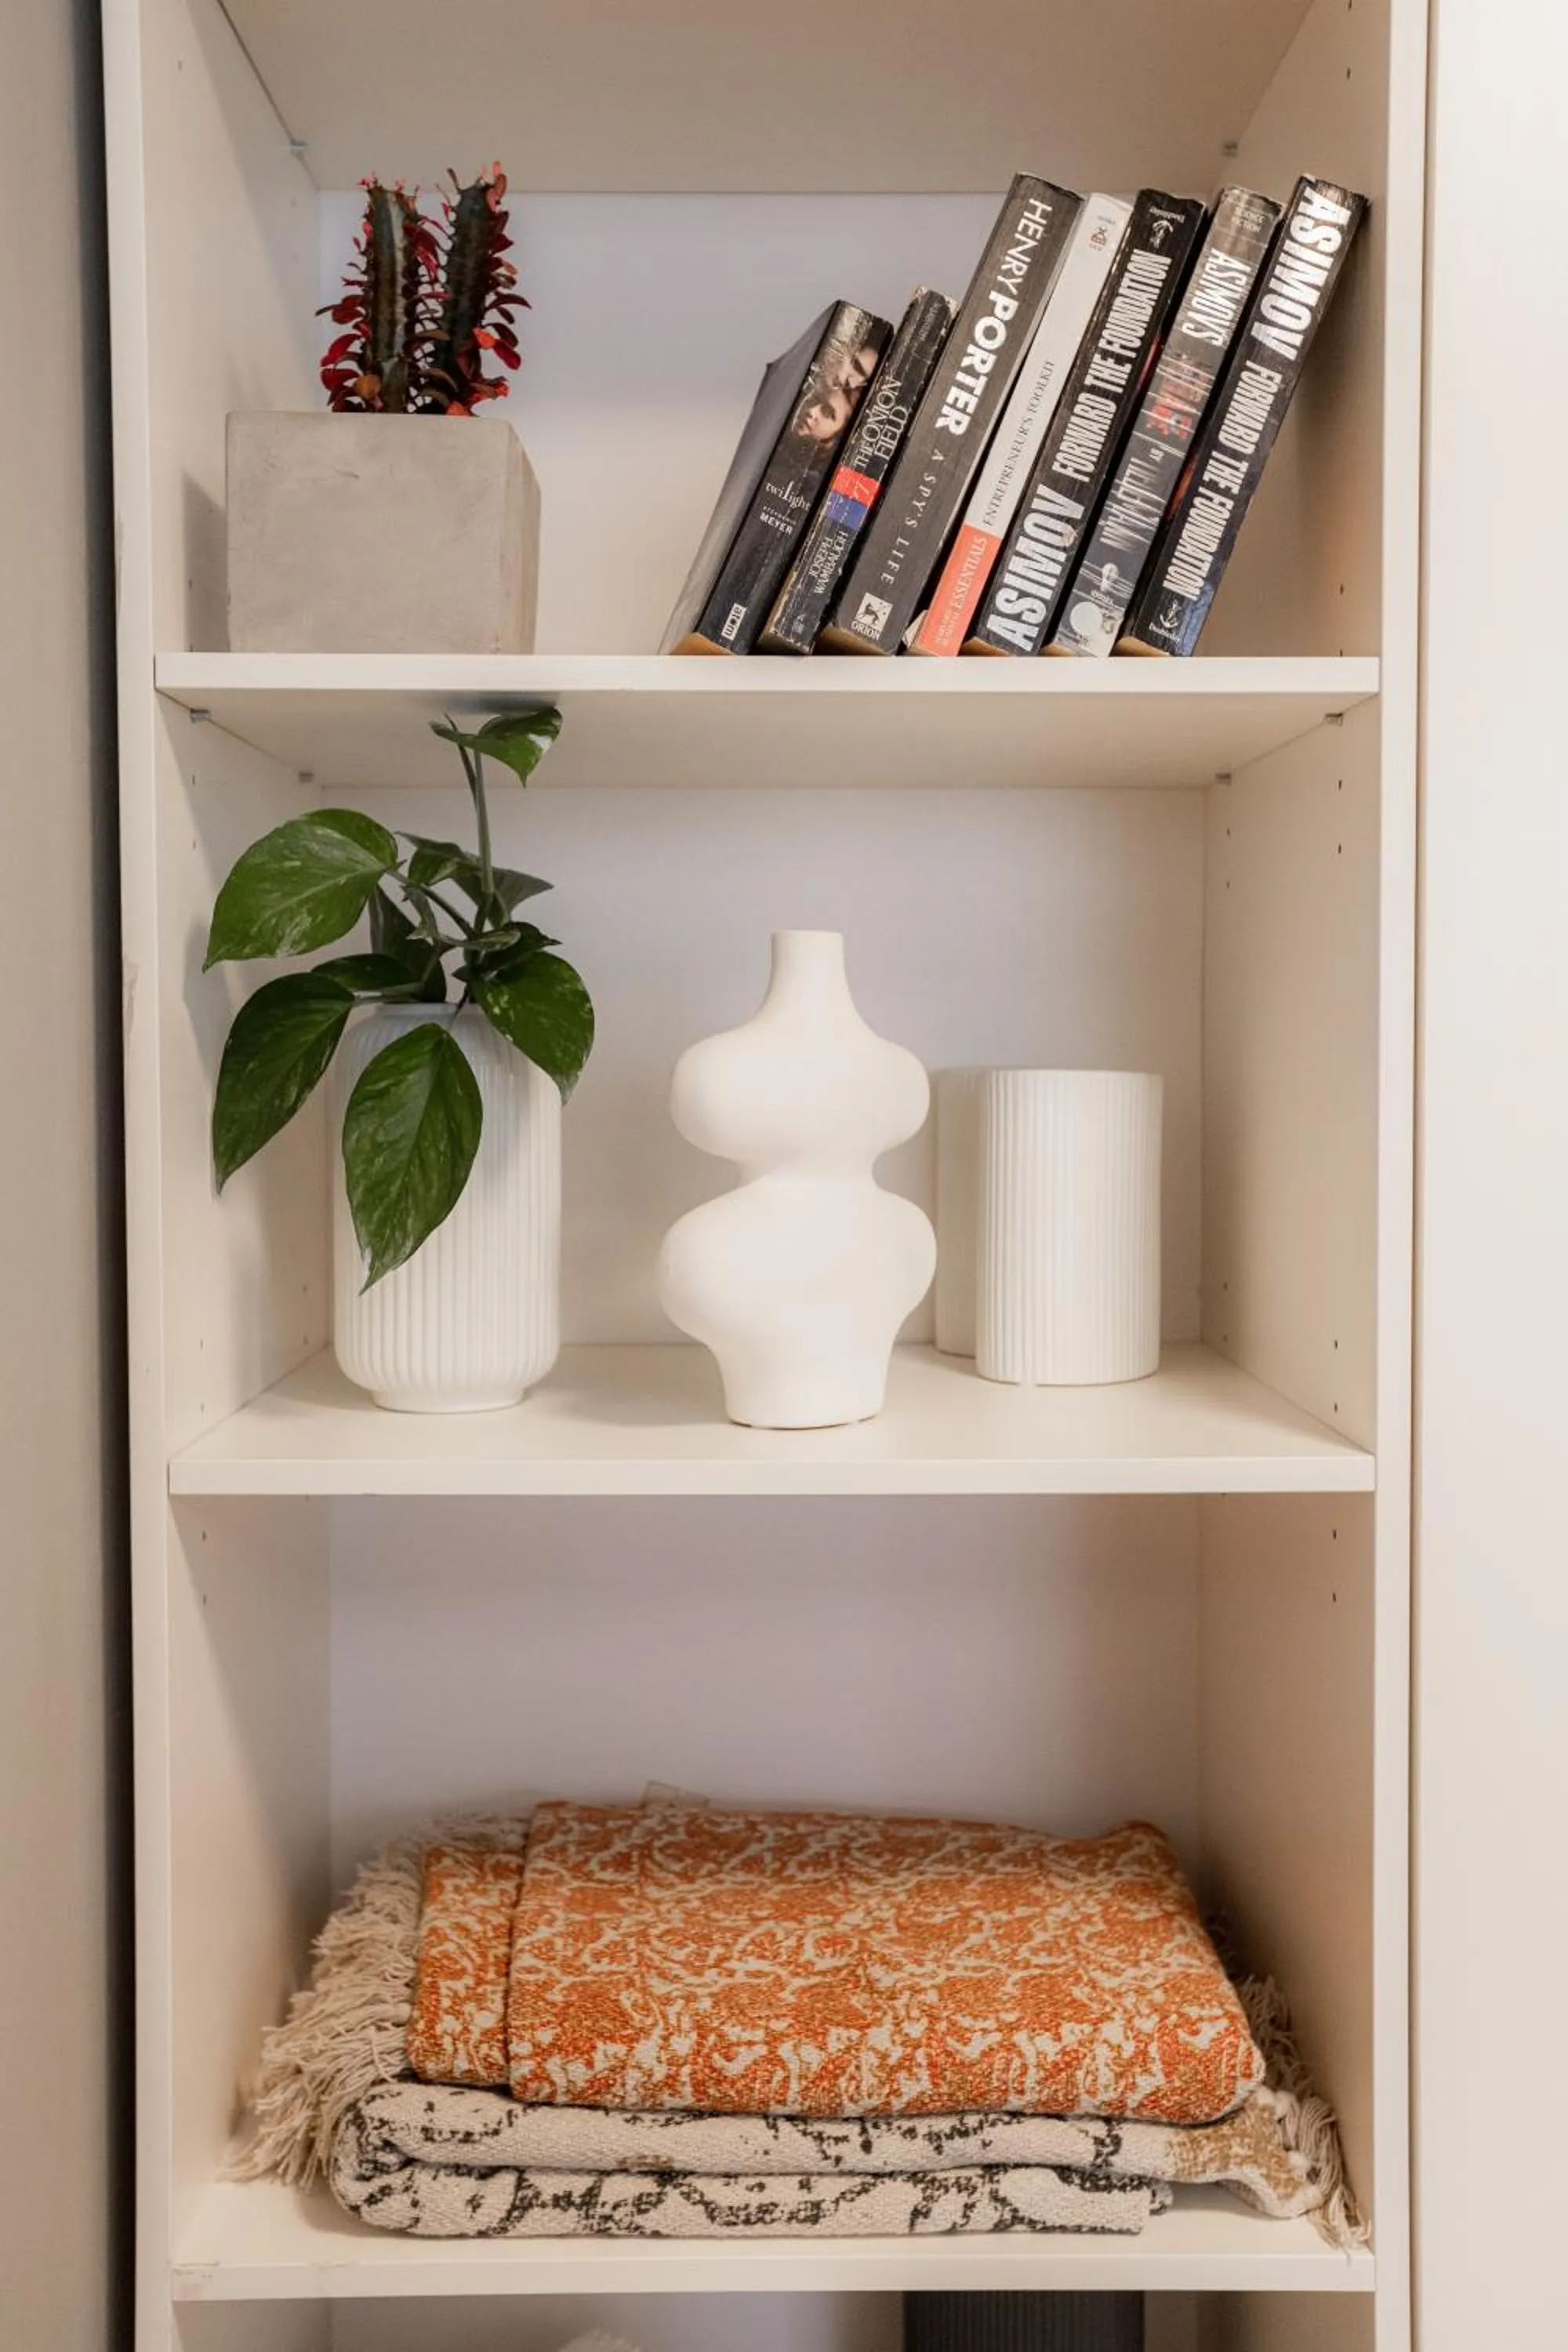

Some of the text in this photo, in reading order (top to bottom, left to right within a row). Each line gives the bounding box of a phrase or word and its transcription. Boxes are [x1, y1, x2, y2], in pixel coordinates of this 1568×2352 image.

[935, 198, 1053, 436] HENRY PORTER
[1026, 358, 1055, 414] TOOLKIT
[1163, 187, 1352, 601] ASIMOV FORWARD THE FOUNDATION
[855, 377, 902, 468] THE ONION
[874, 406, 909, 461] FIELD
[986, 249, 1172, 652] ASIMOV FORWARD THE FOUNDATION
[760, 511, 794, 535] MEYER
[764, 480, 811, 511] twilight
[880, 448, 945, 585] A SPY'S LIFE
[809, 537, 833, 579] JOSEPH
[814, 531, 849, 594] WAMBAUGH
[952, 536, 988, 610] ESSENTIALS
[851, 620, 880, 641] ORION
